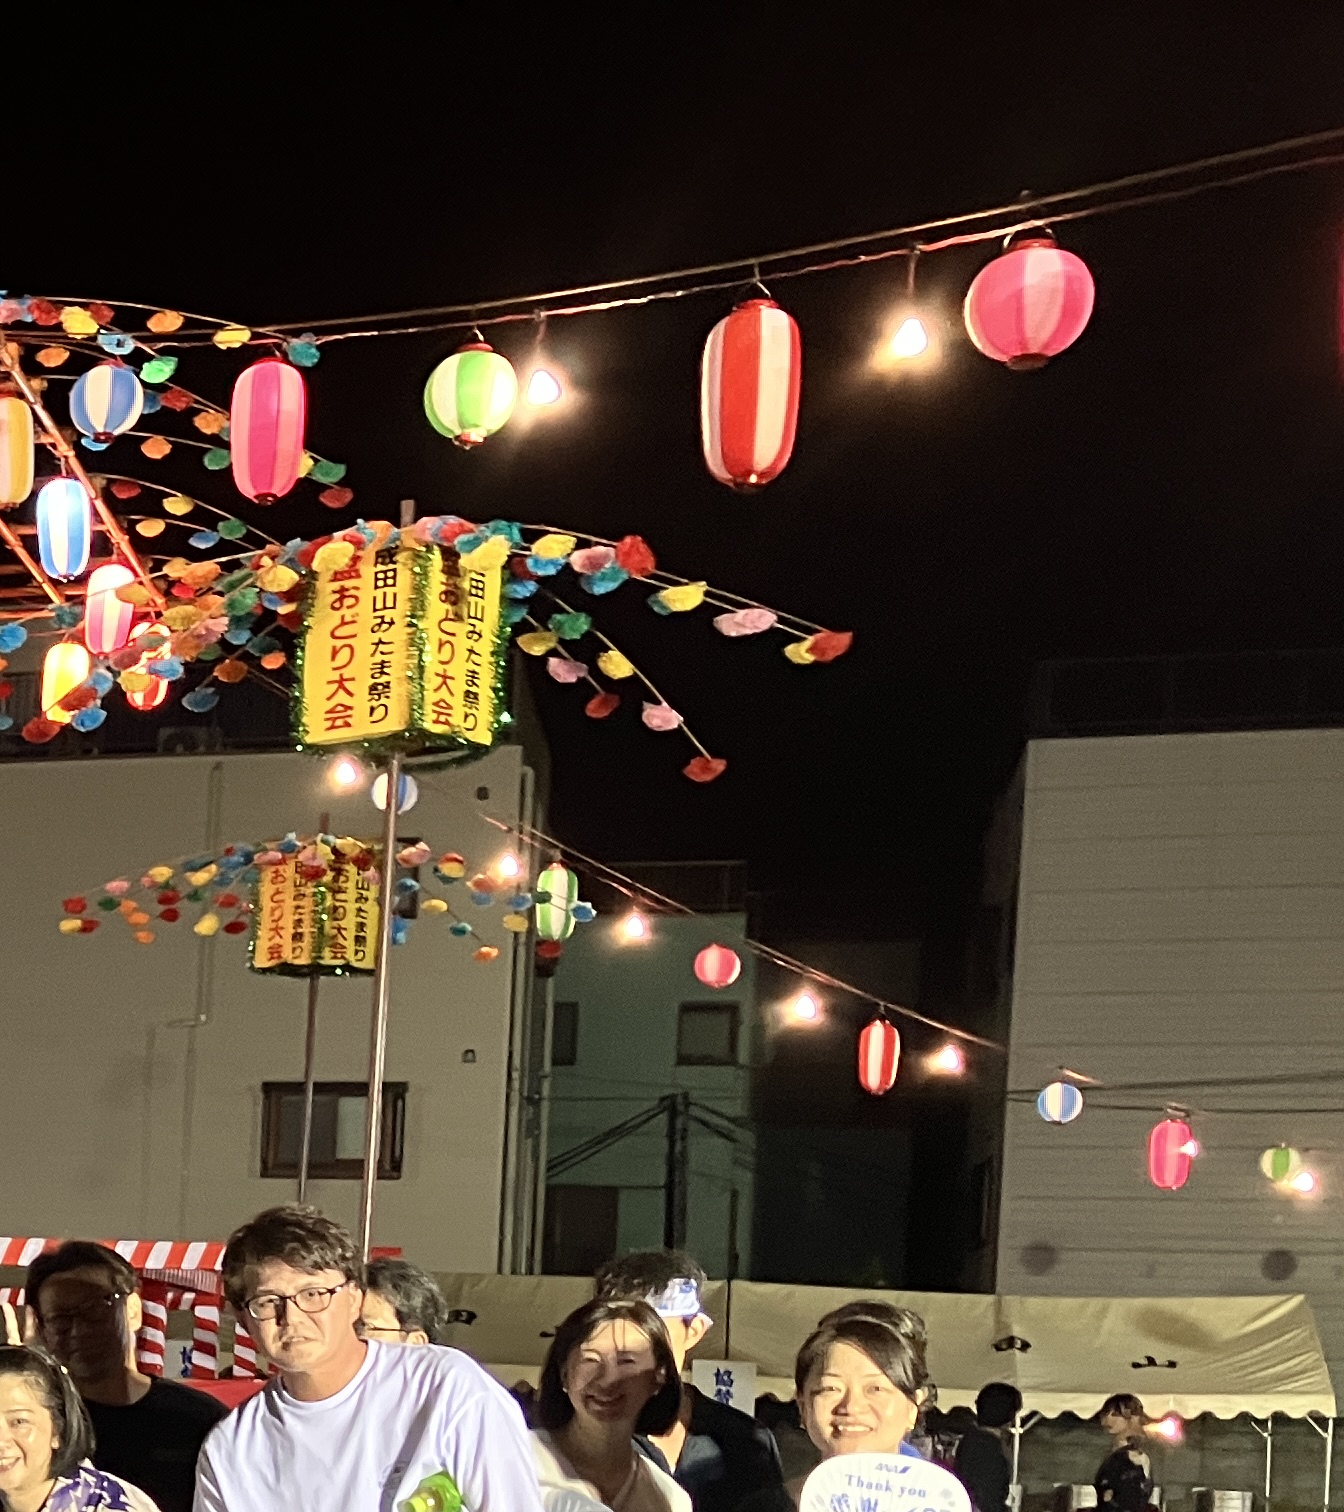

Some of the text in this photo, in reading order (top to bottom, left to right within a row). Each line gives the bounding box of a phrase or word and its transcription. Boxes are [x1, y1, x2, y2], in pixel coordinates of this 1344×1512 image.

[367, 546, 398, 725] 成田山みたま祭り
[845, 1474, 926, 1498] Thank you
